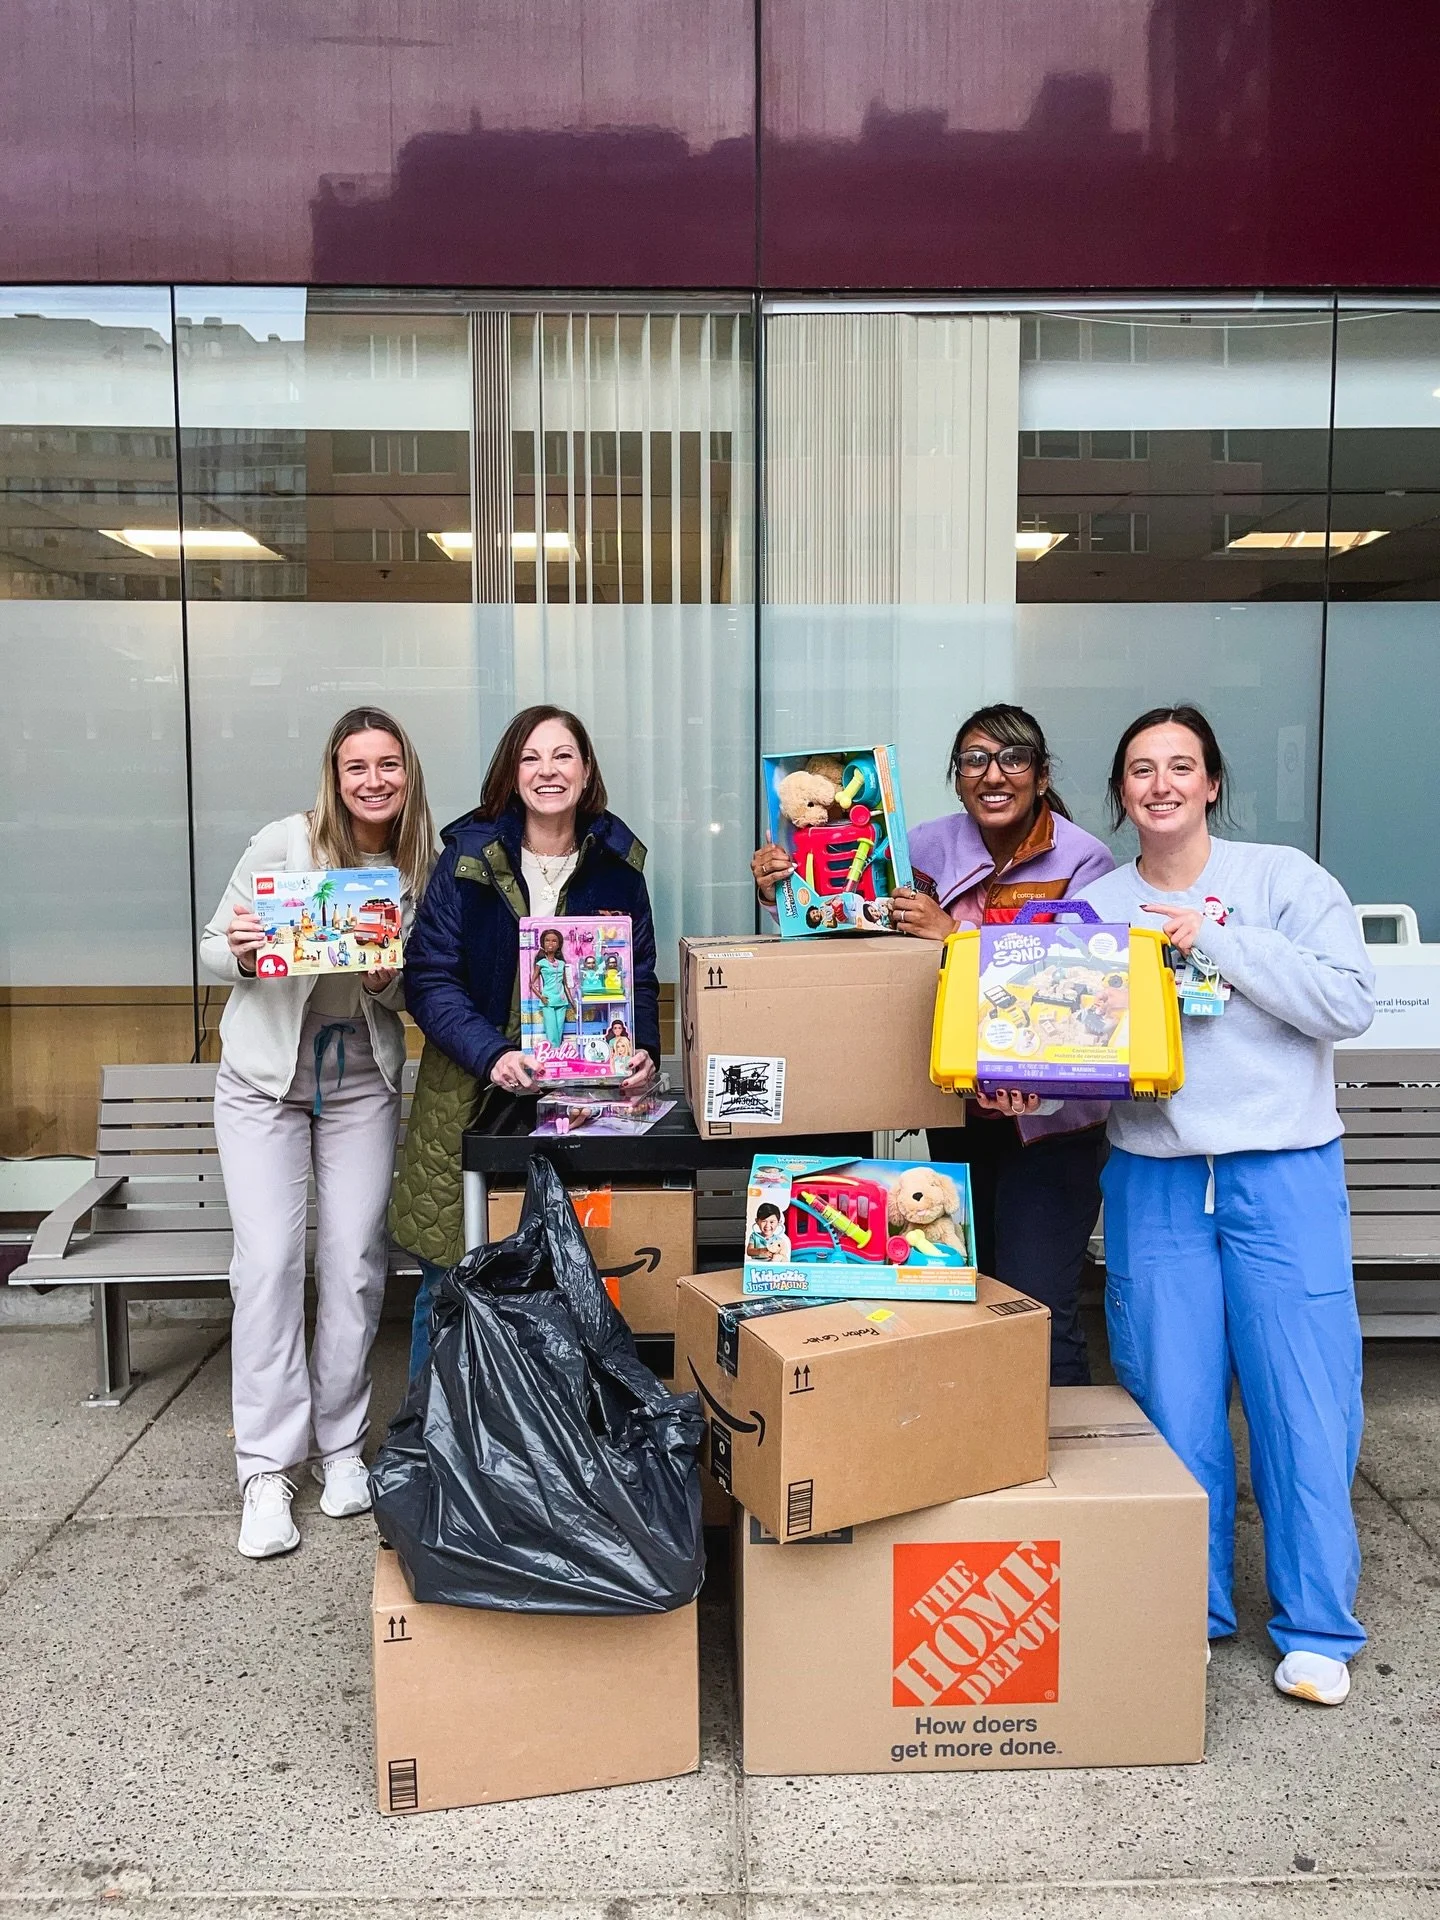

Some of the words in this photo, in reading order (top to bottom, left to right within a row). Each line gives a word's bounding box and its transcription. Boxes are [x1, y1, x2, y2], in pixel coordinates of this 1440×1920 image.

[258, 882, 273, 890] LEGO
[260, 958, 286, 974] 4+
[1190, 1003, 1213, 1014] RN
[1395, 998, 1430, 1007] Hospital
[537, 1041, 578, 1061] Barbie
[750, 1268, 807, 1283] Kidoozie
[747, 1282, 769, 1292] JUST
[769, 1281, 809, 1291] IMAGINE
[948, 1288, 960, 1296] 10
[908, 1559, 980, 1626] THE
[893, 1541, 1061, 1706] HOME
[957, 1601, 1061, 1706] DEPOT
[915, 1716, 967, 1735] How
[972, 1715, 1038, 1734] doers
[890, 1741, 928, 1762] get
[934, 1742, 993, 1757] more
